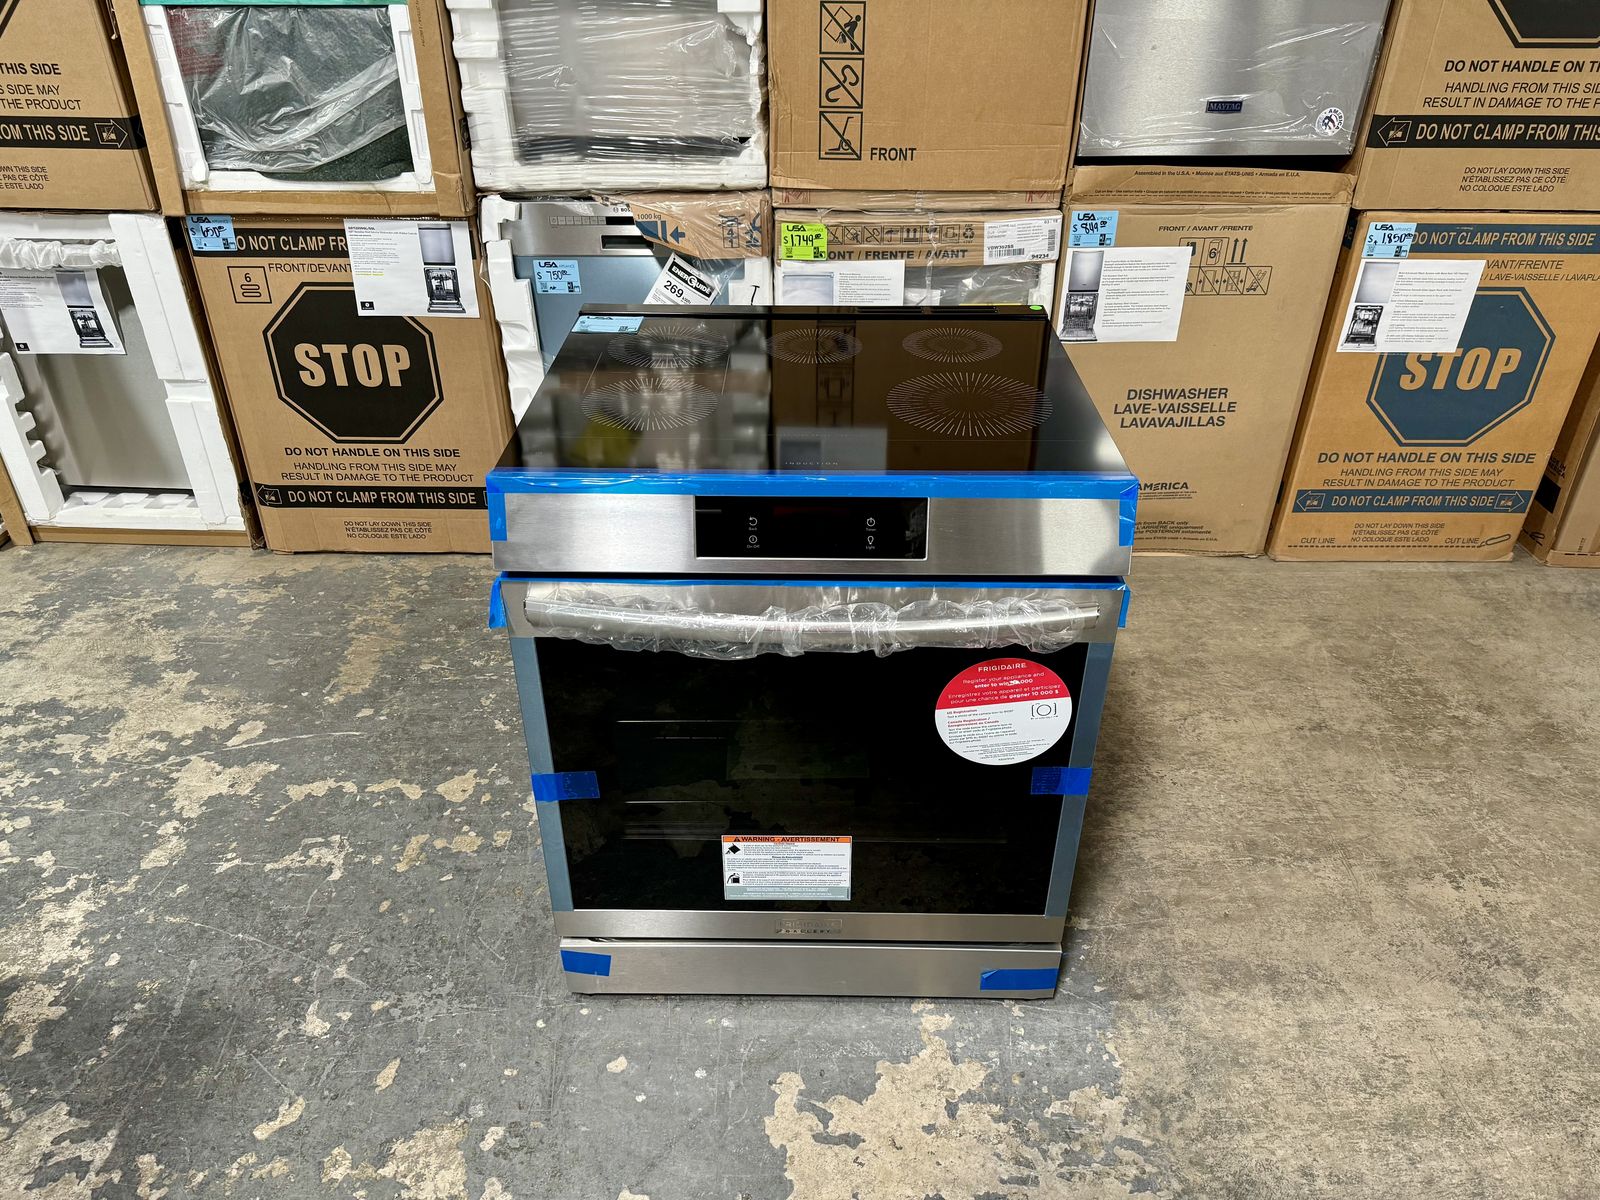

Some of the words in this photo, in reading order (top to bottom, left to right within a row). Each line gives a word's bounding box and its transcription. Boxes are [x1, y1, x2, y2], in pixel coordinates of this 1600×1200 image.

[30, 63, 62, 75] SIDE
[1444, 60, 1465, 72] DO
[1468, 60, 1499, 72] NOT
[1501, 60, 1560, 72] HANDLE
[1563, 60, 1585, 72] ON
[6, 84, 35, 95] SIDE
[36, 85, 60, 96] MAY
[1444, 82, 1508, 93] HANDLING
[1511, 82, 1549, 94] FROM
[1552, 83, 1580, 94] THIS
[1, 99, 24, 110] THE
[26, 99, 82, 110] PRODUCT
[1209, 102, 1241, 112] MAYTAG
[1423, 97, 1471, 108] RESULT
[1472, 98, 1486, 108] IN
[1488, 98, 1544, 108] DAMAGE
[1546, 98, 1563, 108] TO
[1566, 98, 1590, 108] THE
[24, 124, 56, 140] THIS
[58, 126, 90, 141] SIDE
[1416, 124, 1438, 140] DO
[1440, 124, 1472, 140] NOT
[1474, 124, 1524, 140] CLAMP
[1526, 124, 1570, 140] FROM
[870, 148, 917, 161] FRONT
[248, 236, 276, 250] NOT
[280, 236, 326, 251] CLAMP
[1430, 232, 1456, 246] NOT
[1458, 232, 1500, 246] CLAMP
[1500, 232, 1540, 246] FROM
[1540, 233, 1566, 246] THIS
[1566, 233, 1596, 246] SIDE
[865, 250, 914, 260] FRENTE
[925, 250, 968, 260] AVANT
[1208, 248, 1218, 258] 6
[268, 263, 352, 274] FRONT/DEVANT
[1486, 260, 1564, 270] VANT/FRENTE
[244, 272, 252, 282] 6
[1489, 274, 1562, 282] LAVE-VAISSELLE
[664, 280, 684, 298] 269
[294, 343, 411, 388] STOP
[1400, 348, 1522, 390] STOP
[1127, 388, 1228, 400] DISHWASHER
[1114, 402, 1237, 414] LAVE-VAISSELLE
[1120, 416, 1226, 428] LAVAVAJILLAS
[285, 448, 302, 456] DO
[305, 448, 328, 456] NOT
[332, 448, 380, 456] HANDLE
[384, 448, 400, 457] ON
[403, 449, 430, 457] THIS
[434, 449, 460, 458] SIDE
[1318, 452, 1340, 462] DO
[1343, 452, 1374, 463] NOT
[1377, 452, 1436, 463] HANDLE
[1440, 452, 1462, 462] ON
[1466, 452, 1498, 463] THIS
[1502, 452, 1536, 464] SIDE
[294, 462, 346, 470] HANDLING
[350, 463, 380, 471] FROM
[382, 463, 406, 472] THIS
[408, 464, 433, 472] SIDE
[436, 464, 456, 472] MAY
[1340, 468, 1393, 476] HANDLING
[1396, 468, 1426, 476] FROM
[1430, 468, 1452, 476] THIS
[1454, 468, 1478, 476] SIDE
[1480, 468, 1504, 476] MAY
[281, 472, 320, 480] RESULT
[336, 473, 380, 481] DAMAGE
[423, 474, 474, 482] PRODUCT
[1322, 478, 1363, 486] RESULT
[1376, 478, 1421, 486] DAMAGE
[1424, 478, 1438, 486] TO
[1441, 478, 1461, 486] THE
[1462, 479, 1515, 487] PRODUCT
[288, 491, 306, 502] DO
[308, 491, 332, 502] NOT
[336, 492, 378, 503] CLAMP
[380, 492, 416, 504] FROM
[418, 492, 446, 504] THIS
[448, 492, 476, 504] SIDE
[1332, 496, 1348, 506] DO
[1349, 496, 1372, 506] NOT
[1373, 496, 1410, 506] CLAMP
[1411, 496, 1442, 506] FROM
[1444, 496, 1468, 506] THIS
[1470, 496, 1496, 506] SIDE
[978, 662, 1027, 672] FRIGIDAIRE
